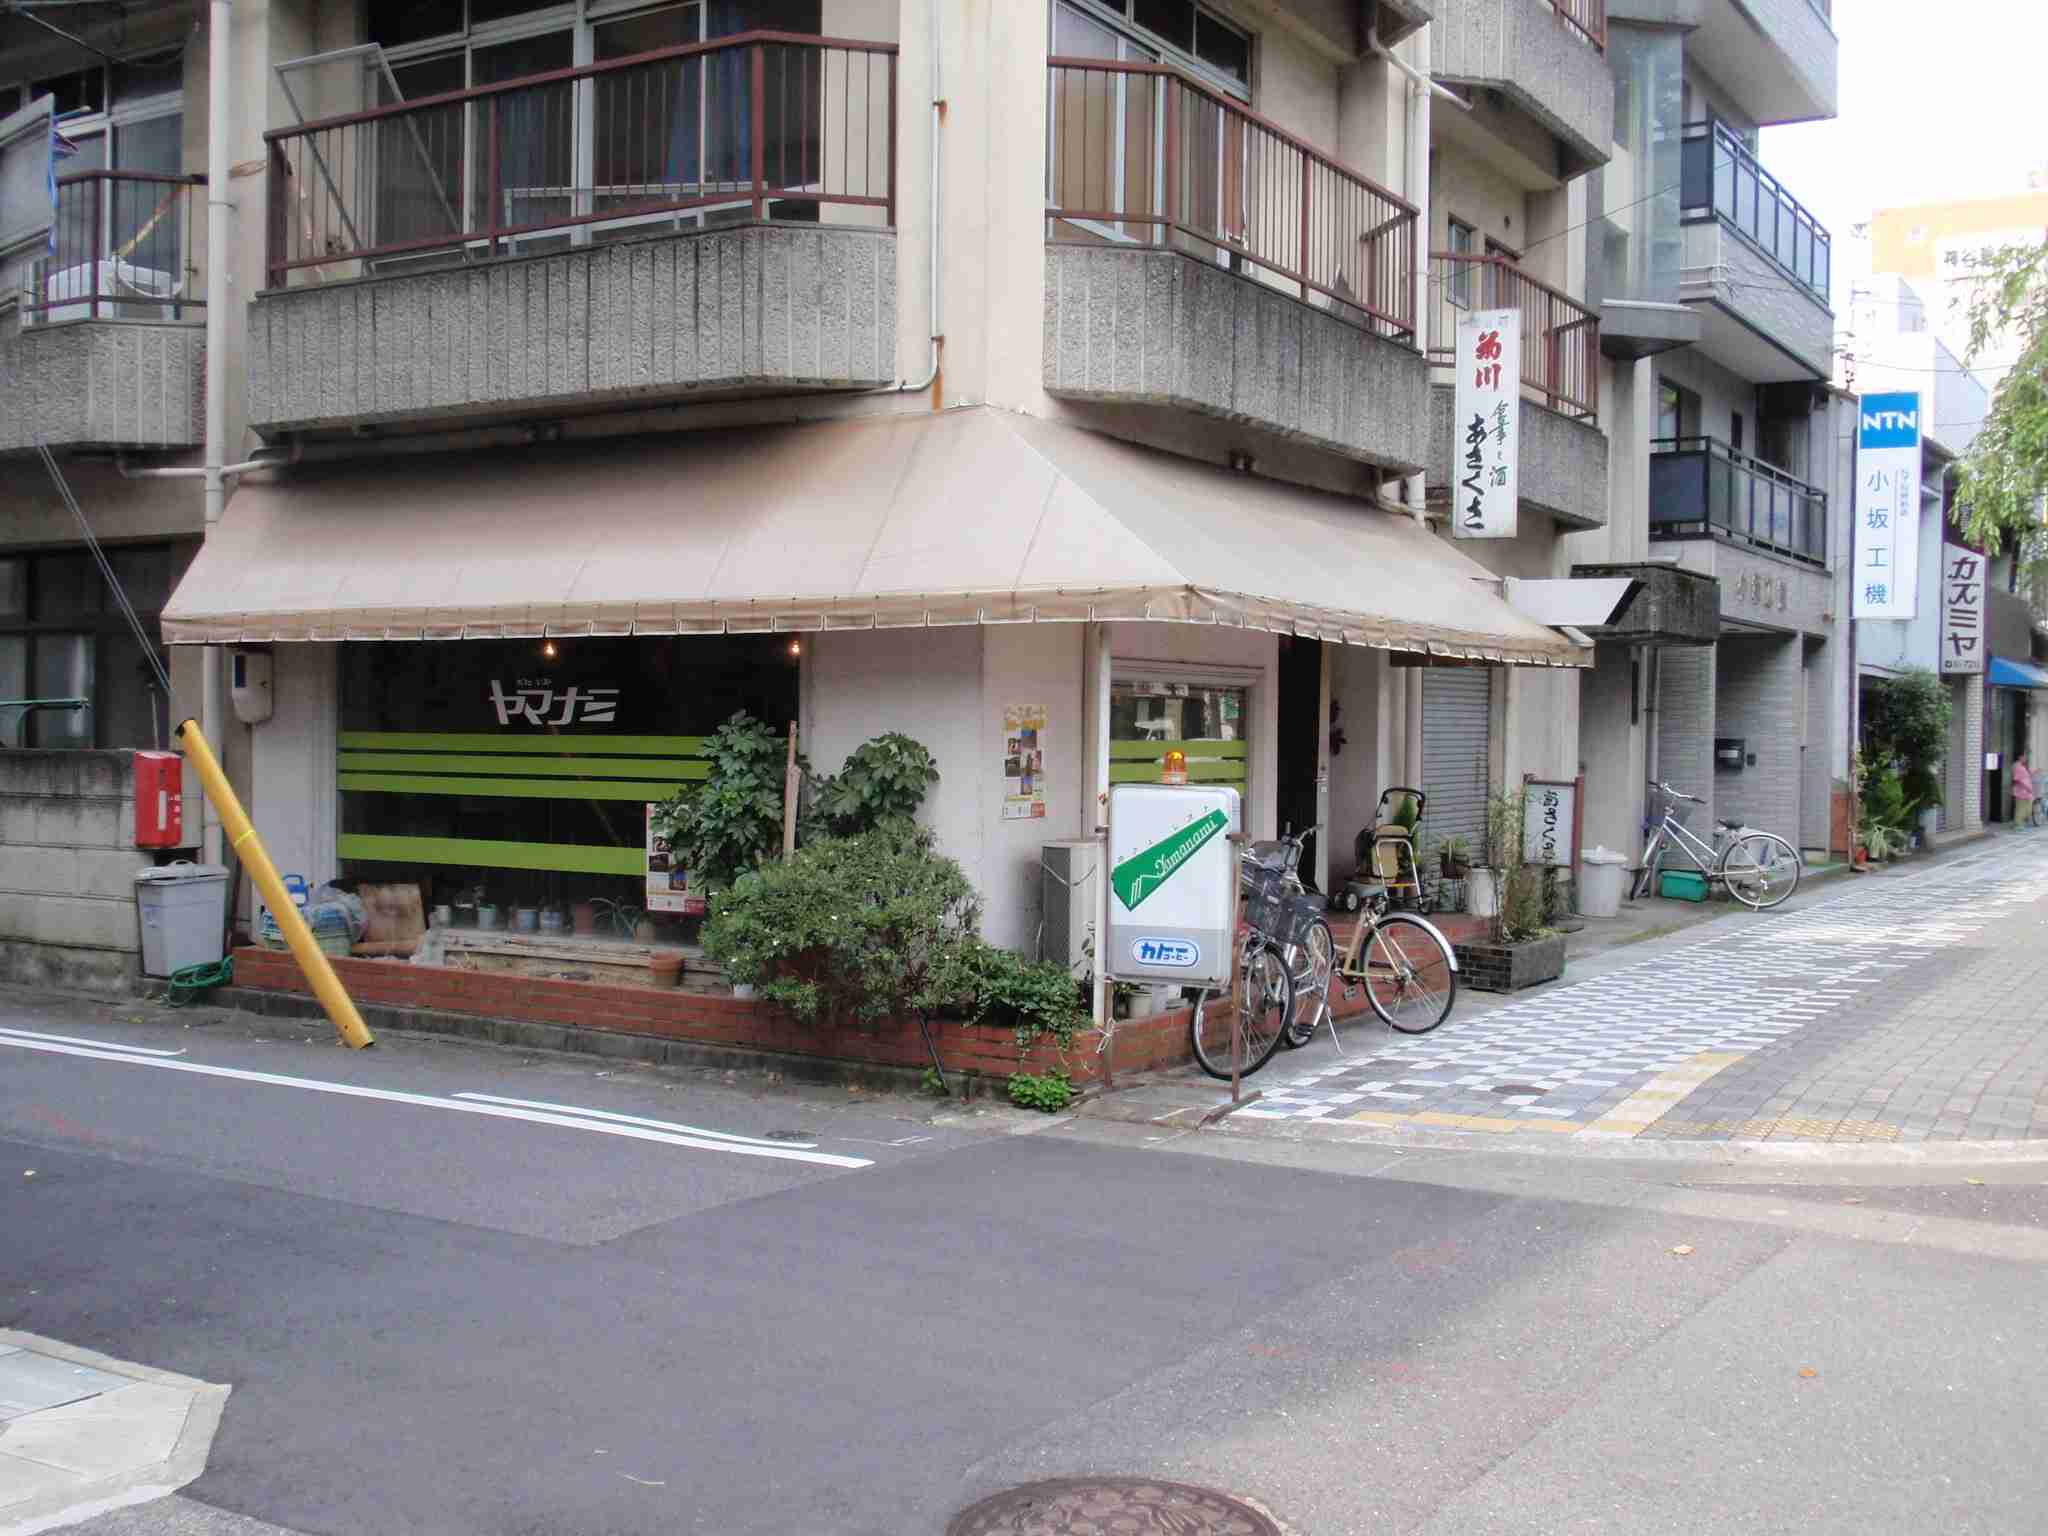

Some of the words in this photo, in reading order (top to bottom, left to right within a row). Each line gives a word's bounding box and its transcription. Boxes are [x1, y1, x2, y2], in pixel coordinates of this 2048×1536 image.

[1862, 410, 1917, 432] NTN
[1865, 470, 1889, 605] 小坂工機
[489, 679, 620, 725] ヤマナミ
[1154, 814, 1218, 876] Yamanami
